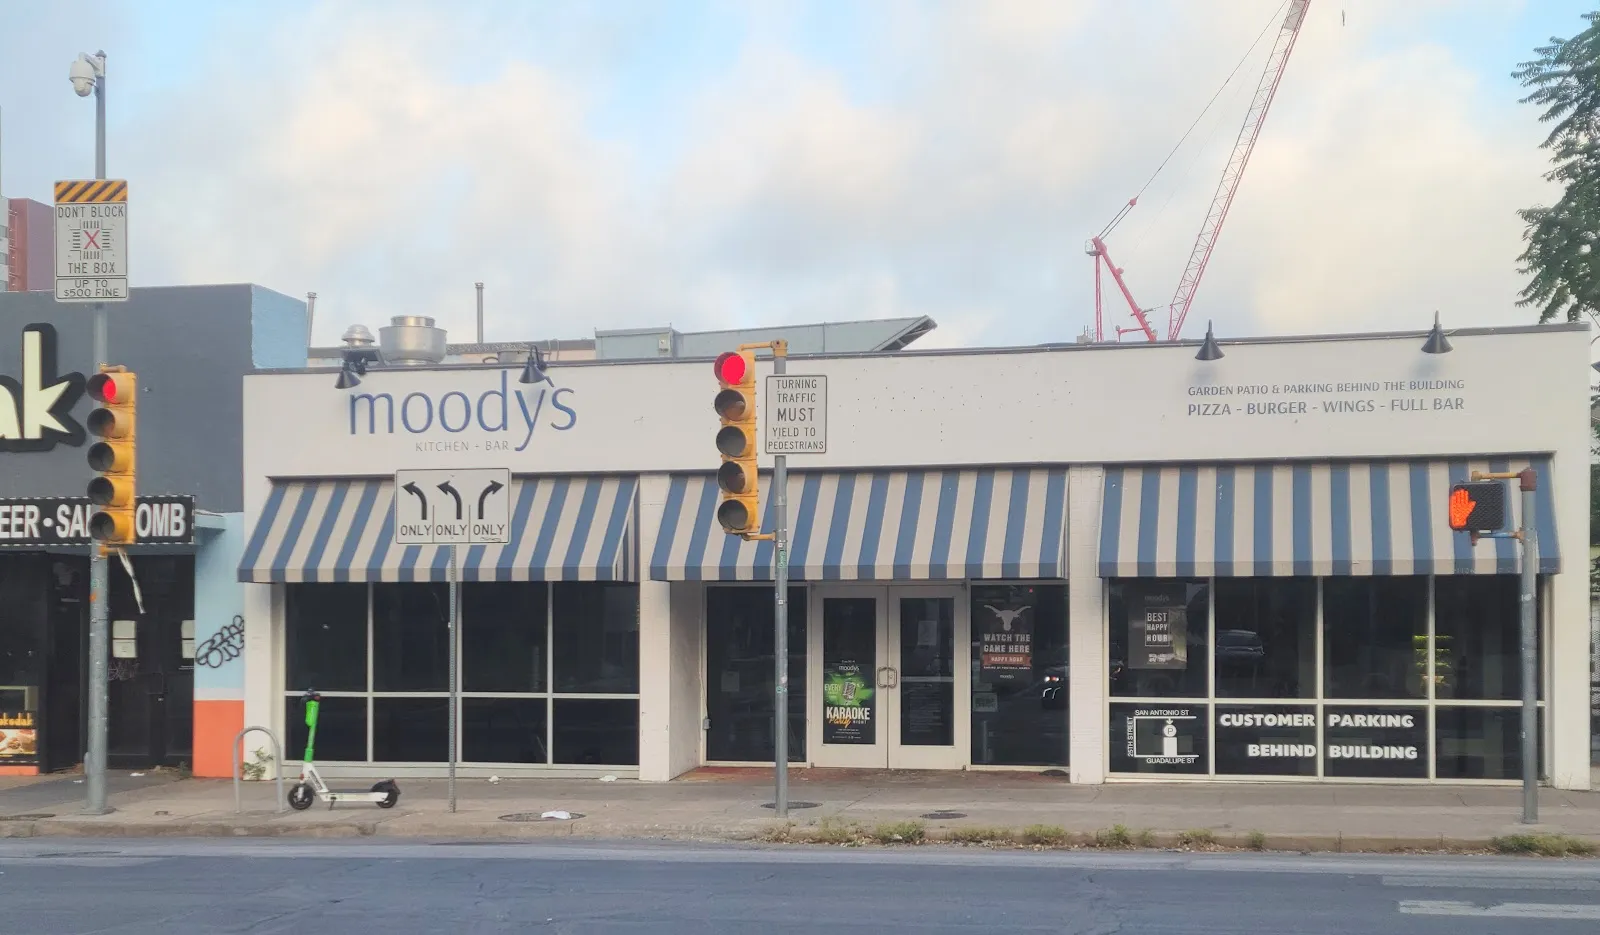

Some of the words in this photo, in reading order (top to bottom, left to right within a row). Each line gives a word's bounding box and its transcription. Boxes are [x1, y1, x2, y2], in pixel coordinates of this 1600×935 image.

[91, 206, 124, 217] BLOCK
[68, 262, 88, 274] THE
[94, 262, 115, 274] BOX
[75, 280, 89, 288] UP
[95, 279, 108, 288] TO
[95, 289, 119, 297] FINE
[776, 380, 817, 389] TURNING
[1188, 386, 1234, 396] GARDEN
[1237, 385, 1269, 395] PATIO
[1272, 384, 1281, 394] &
[1284, 383, 1333, 393] PARKING
[1337, 382, 1380, 392] BEHIND
[1384, 381, 1406, 391] THE
[1410, 379, 1465, 390] BUILDING
[777, 393, 816, 403] TRAFFIC
[1188, 404, 1231, 416] PIZZA
[1247, 402, 1307, 415] BURGER
[1323, 400, 1375, 412] WINGS
[1391, 399, 1428, 411] FULL
[1434, 398, 1464, 410] BAR
[777, 408, 815, 421] MUST
[773, 427, 799, 437] YIELD
[805, 427, 816, 437] TO
[415, 441, 469, 452] KITCHEN
[485, 440, 509, 451] BAR
[768, 441, 824, 449] PEDESTRIANS
[56, 504, 92, 538] SA
[135, 503, 186, 538] OMB
[400, 525, 432, 536] ONLY
[436, 525, 467, 536] ONLY
[473, 524, 505, 535] ONLY
[1147, 612, 1168, 621] BEST
[1146, 623, 1168, 631] HAPPY
[984, 633, 1012, 642] WATCH
[1015, 633, 1031, 642] THE
[1146, 634, 1168, 642] HOUR
[984, 644, 1006, 653] GAME
[1008, 645, 1030, 653] HERE
[826, 706, 871, 720] KARAOKE
[1220, 713, 1316, 727] CUSTOMER
[1328, 714, 1414, 728] PARKING
[1126, 716, 1134, 740] STREET
[1167, 727, 1174, 735] P
[1247, 743, 1317, 757] BEHIND
[1328, 745, 1418, 760] BUILDING
